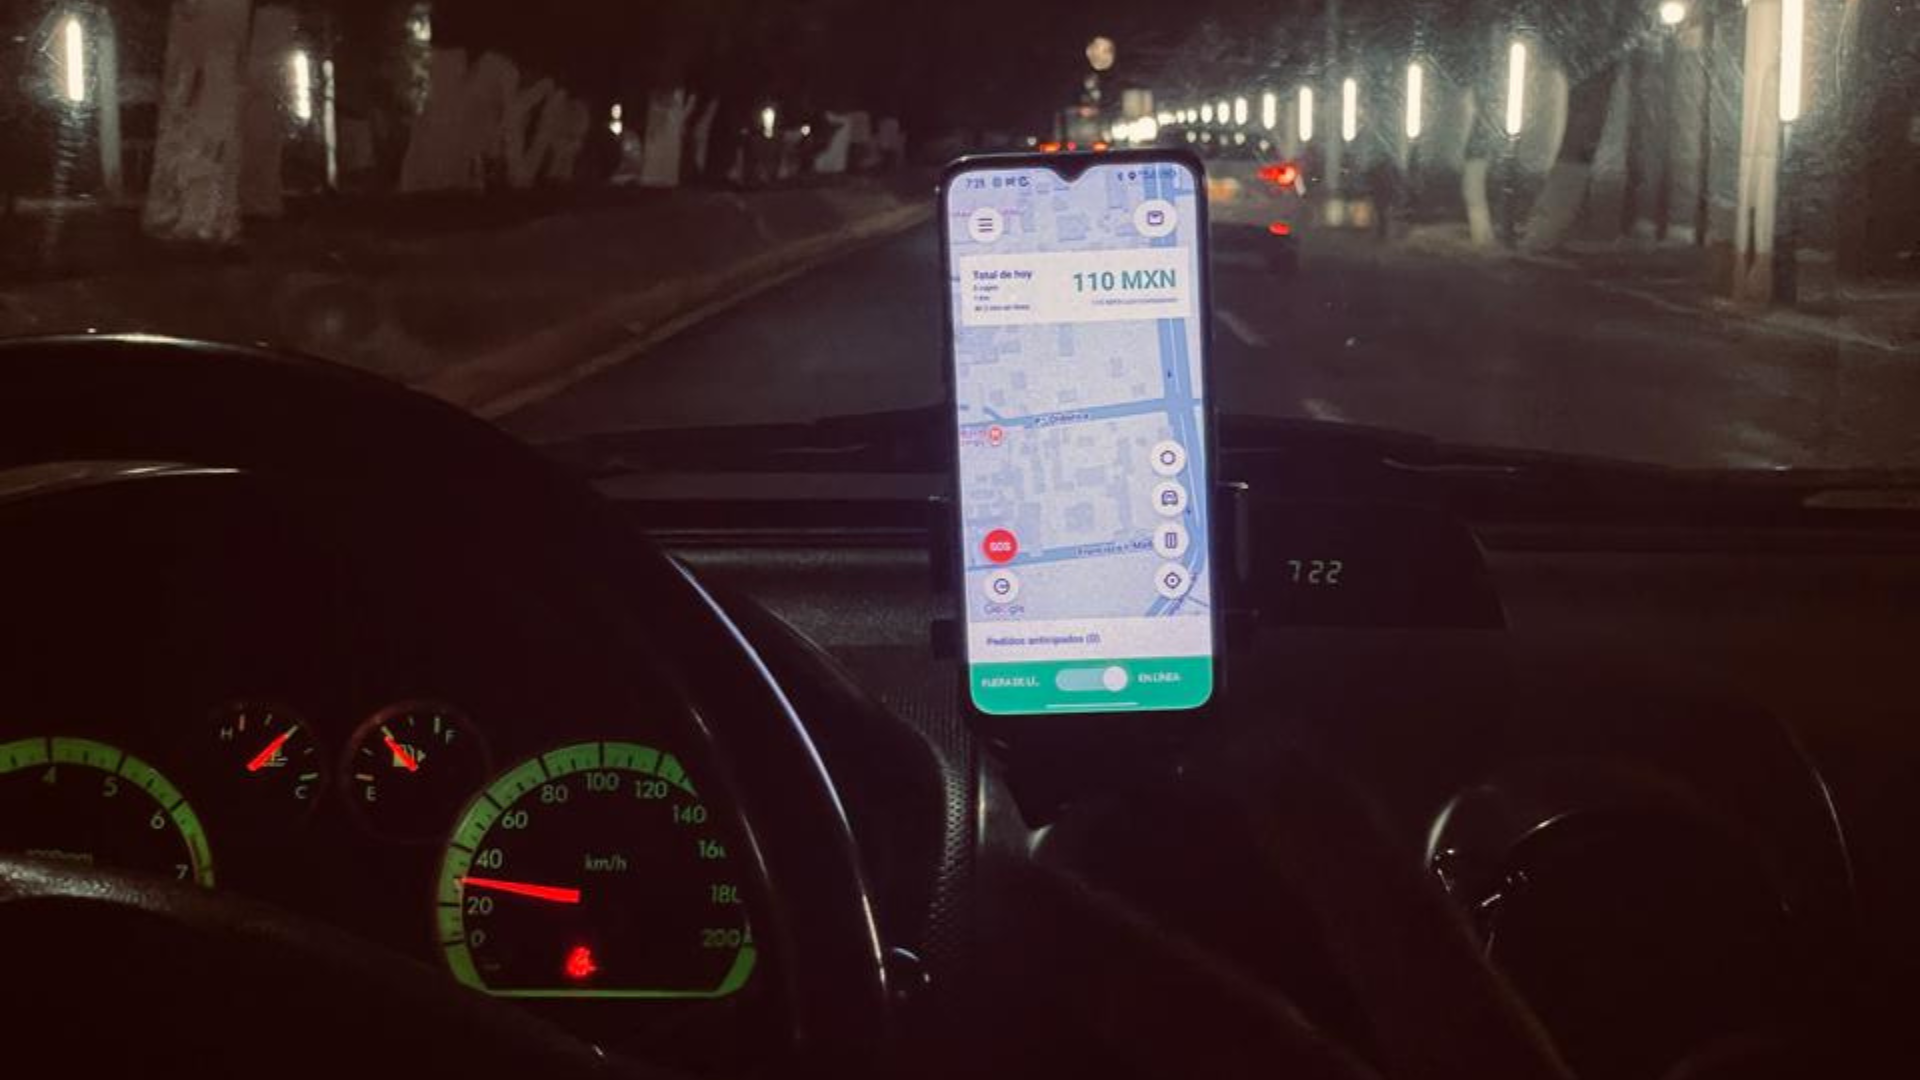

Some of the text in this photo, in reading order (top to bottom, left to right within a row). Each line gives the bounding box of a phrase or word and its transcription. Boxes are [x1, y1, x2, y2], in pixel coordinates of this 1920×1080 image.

[973, 269, 1032, 283] Total de hoy
[1073, 269, 1176, 292] 110 MXN
[989, 541, 1012, 552] SOS
[986, 635, 1025, 645] Pedidos
[220, 726, 233, 741] H
[445, 730, 455, 744] F
[40, 766, 58, 785] 4
[584, 773, 620, 792] 100
[102, 776, 119, 798] 5
[295, 785, 308, 800] C
[366, 785, 377, 802] E
[540, 785, 569, 804] 80
[635, 780, 669, 800] 120
[150, 808, 166, 830] 6
[501, 810, 529, 830] 60
[672, 804, 707, 824] 140
[474, 848, 504, 870] 40
[584, 853, 629, 871] km/h
[174, 863, 190, 880] 7
[466, 895, 494, 916] 20
[470, 929, 487, 948] 0
[702, 928, 742, 949] 200
